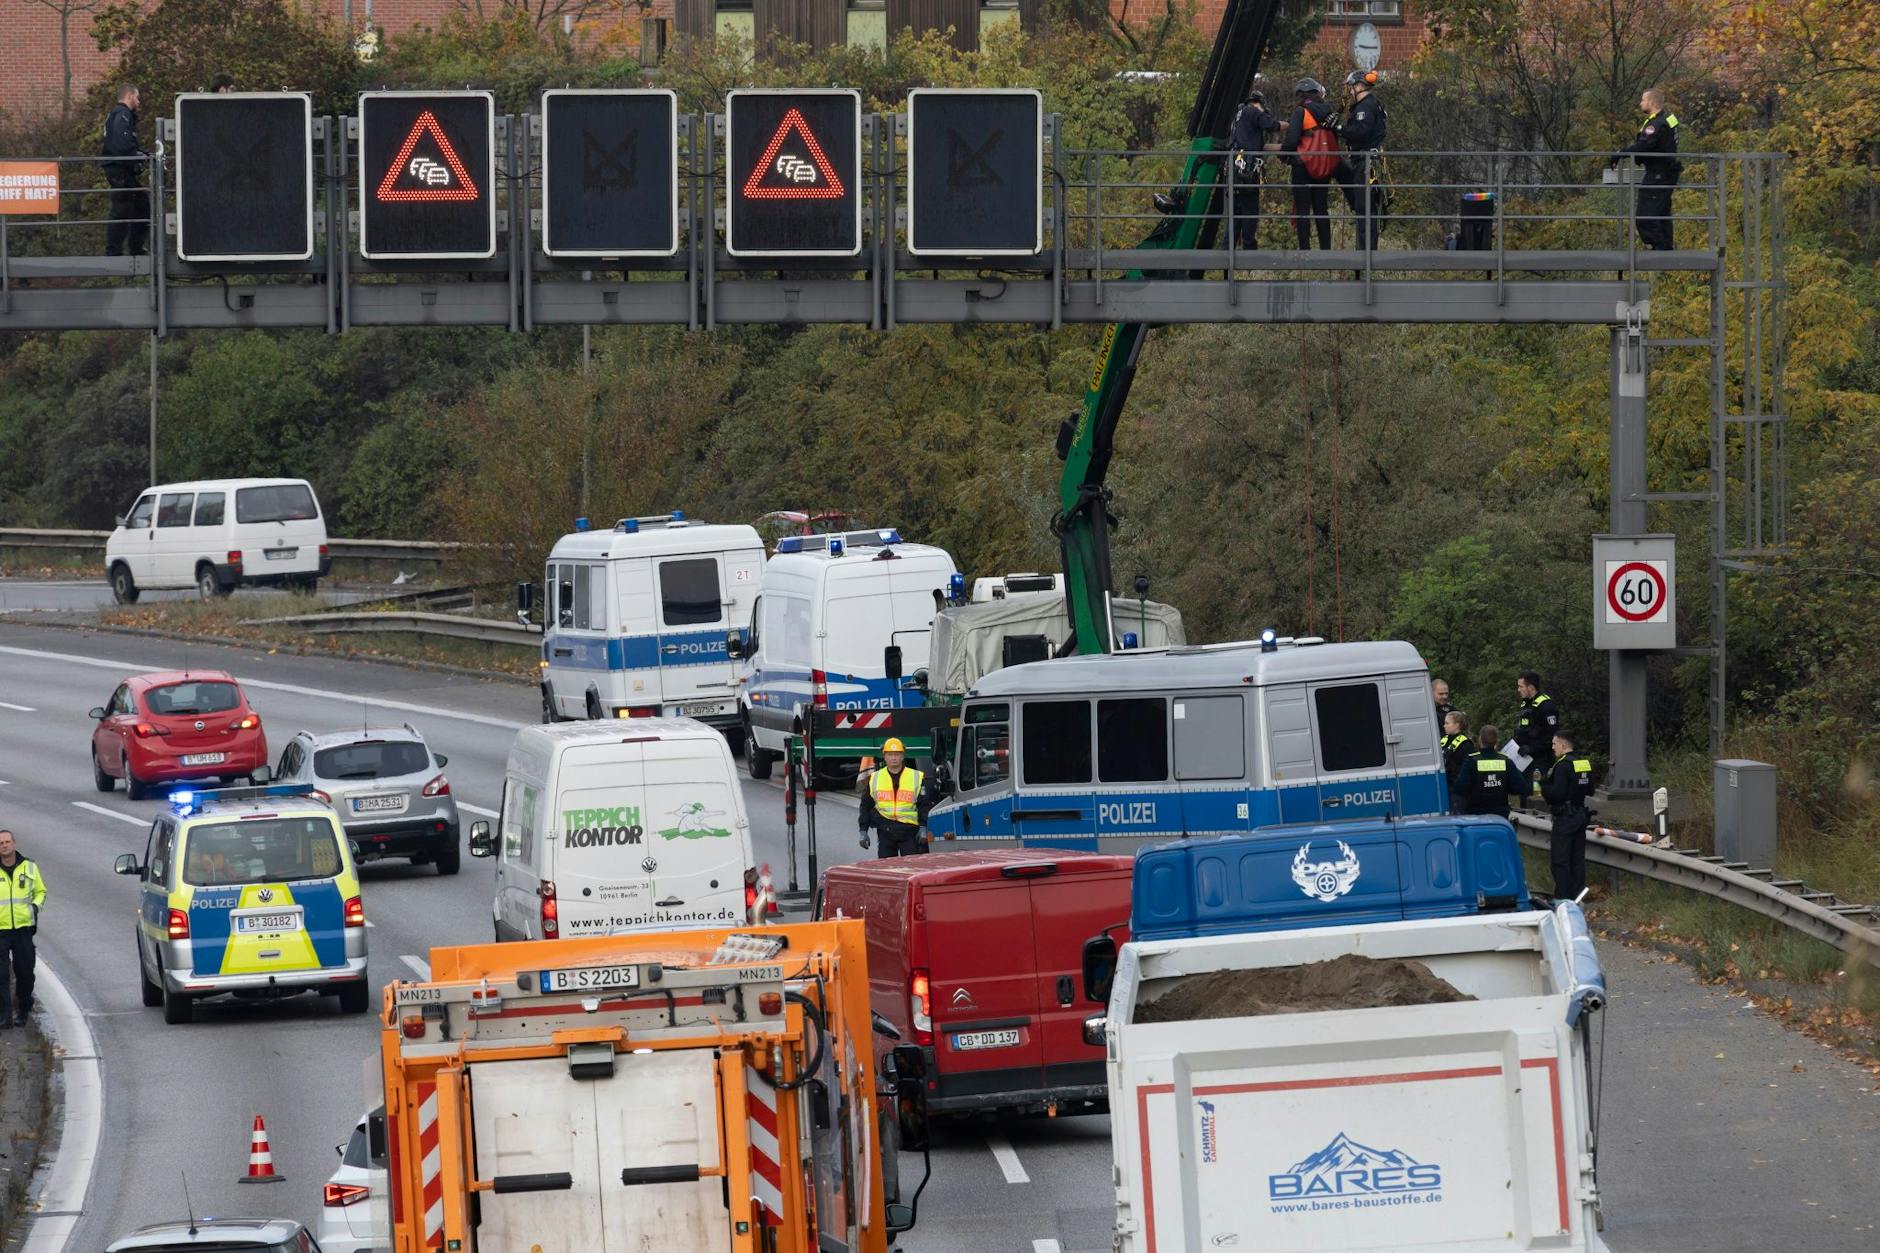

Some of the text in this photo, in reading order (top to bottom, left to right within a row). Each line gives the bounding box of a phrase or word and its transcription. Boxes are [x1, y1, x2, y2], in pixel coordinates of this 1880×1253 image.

[24, 187, 57, 200] HAT?
[1620, 578, 1653, 606] 60
[680, 641, 727, 655] POLIZE
[1344, 789, 1395, 807] POLIZEI
[562, 806, 640, 830] TEPPICH
[1099, 802, 1157, 825] POLIZEI
[1238, 805, 1248, 817] 36
[565, 825, 643, 848] KONTOR
[191, 898, 238, 910] POLIZEI
[248, 918, 255, 928] B
[557, 972, 568, 988] B
[739, 967, 780, 980] MN213
[400, 989, 441, 1001] MN213
[960, 1031, 1017, 1046] CB DD 137
[1202, 1116, 1211, 1163] SCHMITZ
[1269, 1164, 1441, 1198] BARES
[1271, 1193, 1442, 1213] www.bares-baustoffe.de
